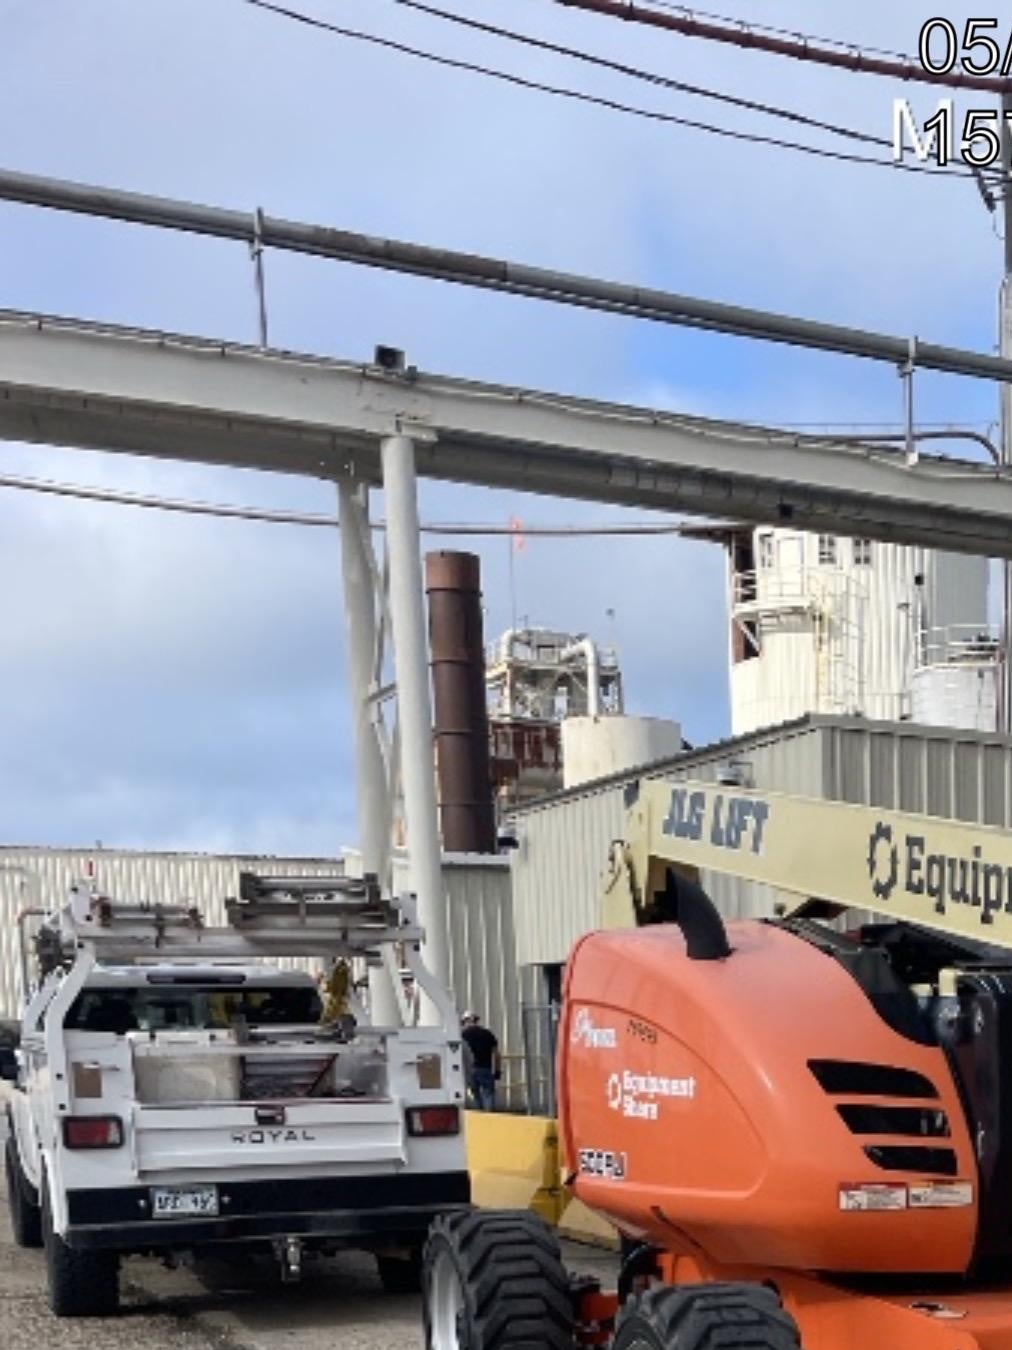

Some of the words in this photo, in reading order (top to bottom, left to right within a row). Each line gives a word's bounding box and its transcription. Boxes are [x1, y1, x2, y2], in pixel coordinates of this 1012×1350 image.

[662, 788, 706, 840] JLG
[710, 794, 770, 855] LIFT
[622, 1070, 695, 1099] Equipment
[231, 1130, 316, 1144] ROYAL
